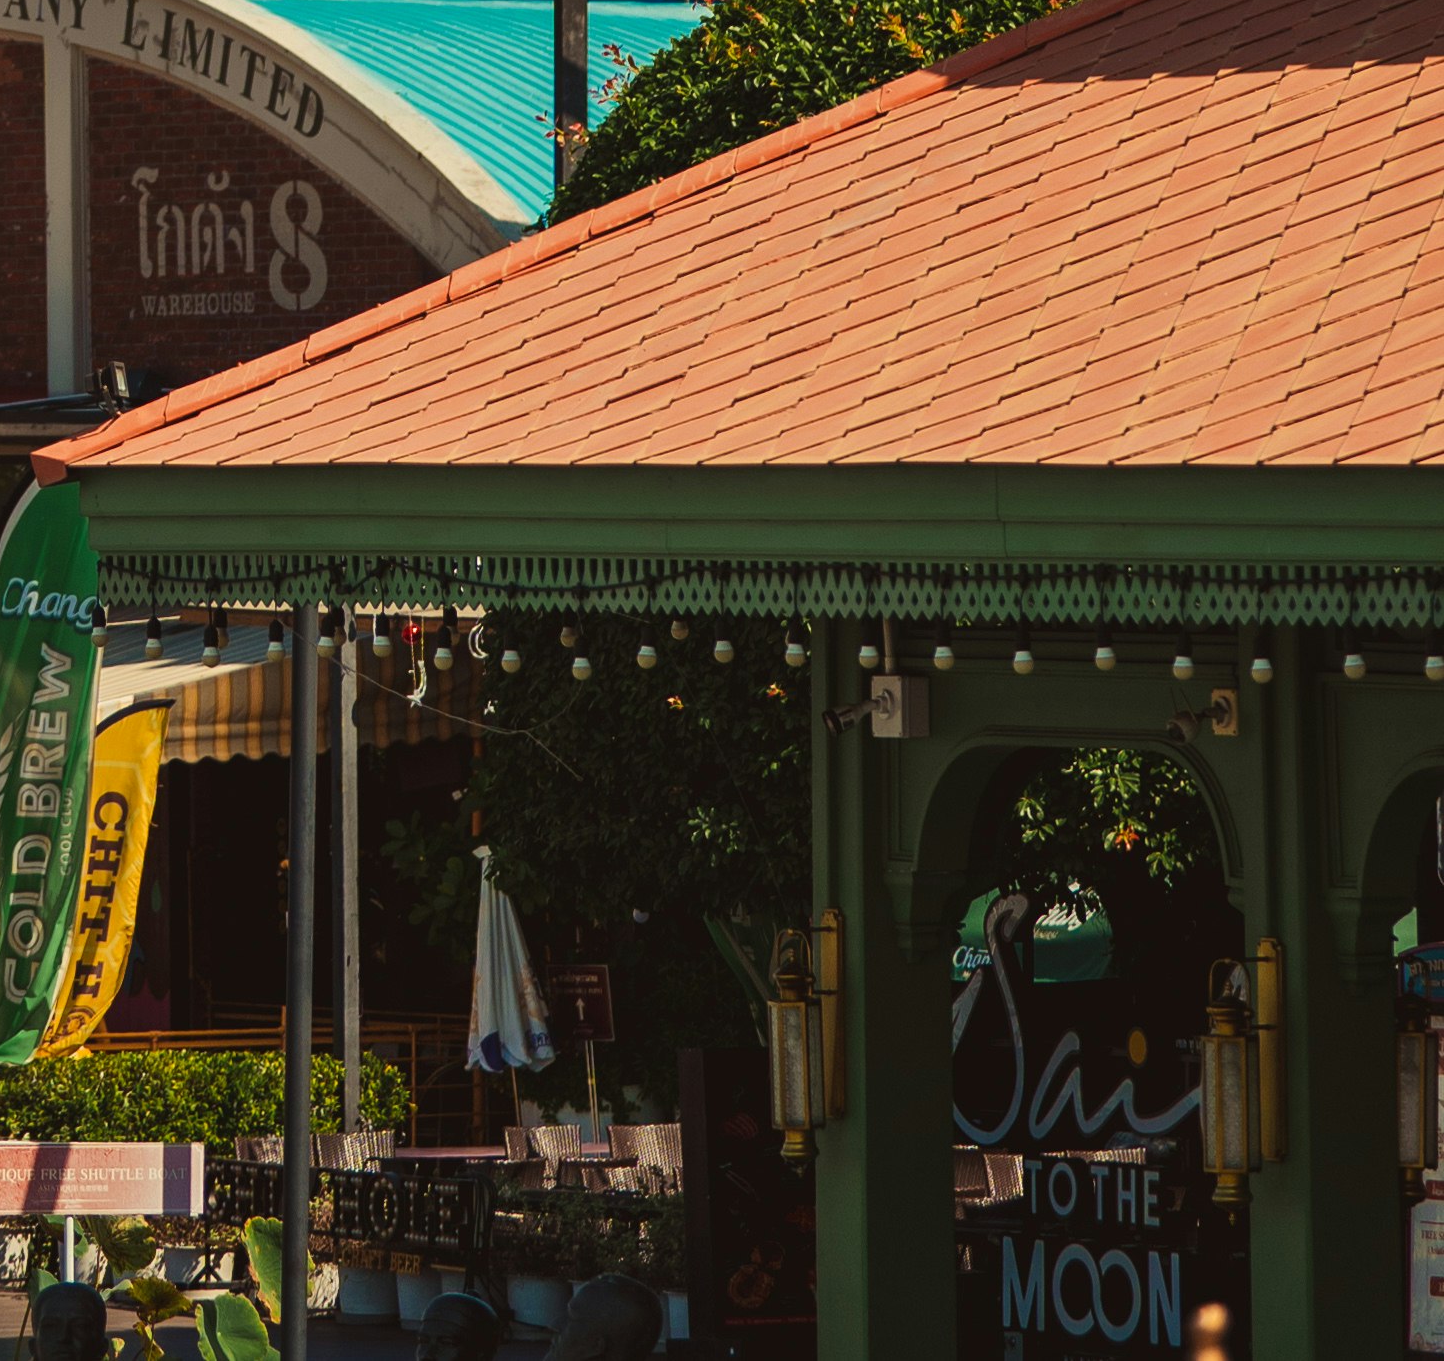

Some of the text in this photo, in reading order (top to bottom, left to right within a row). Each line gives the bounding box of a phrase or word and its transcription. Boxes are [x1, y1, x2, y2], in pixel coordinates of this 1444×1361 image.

[131, 166, 328, 310] โกดัง 8
[140, 291, 256, 318] WAREHOUSE
[1, 576, 102, 631] Chang
[4, 641, 73, 1005] COLD BREW
[80, 791, 129, 943] CHIT
[952, 944, 993, 969] Chan
[952, 893, 1201, 1146] Sai
[41, 1167, 75, 1182] FREE
[80, 1167, 144, 1182] SHUTTLE
[148, 1166, 188, 1181] BOAT
[1025, 1159, 1161, 1227] TO THE
[389, 1250, 422, 1276] BEER
[1002, 1235, 1182, 1348] MOON
